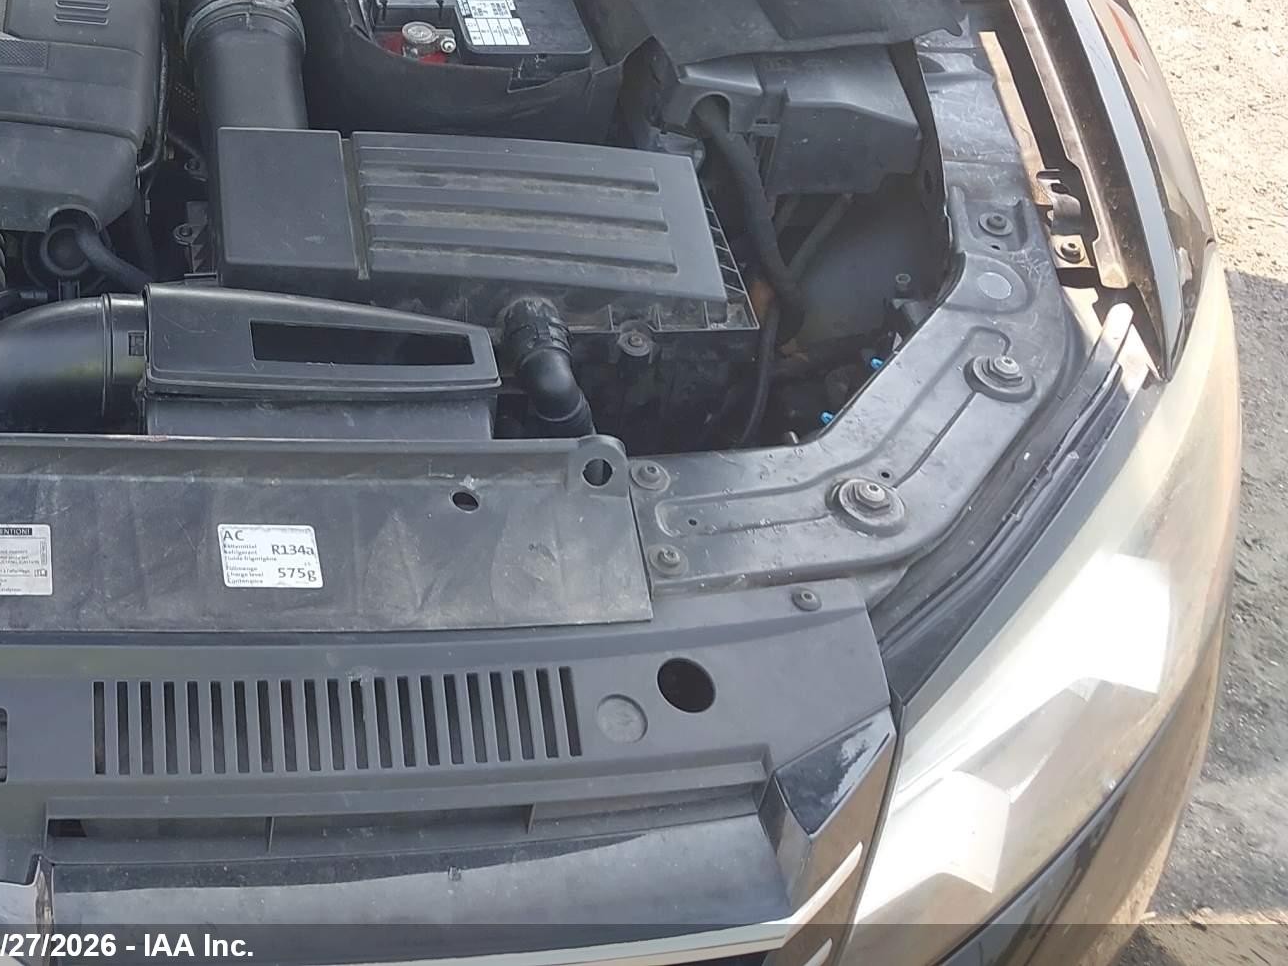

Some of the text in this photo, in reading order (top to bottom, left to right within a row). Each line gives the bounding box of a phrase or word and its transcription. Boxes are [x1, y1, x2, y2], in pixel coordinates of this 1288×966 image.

[223, 530, 244, 541] AC
[271, 544, 314, 555] R134a
[278, 567, 317, 582] 575g
